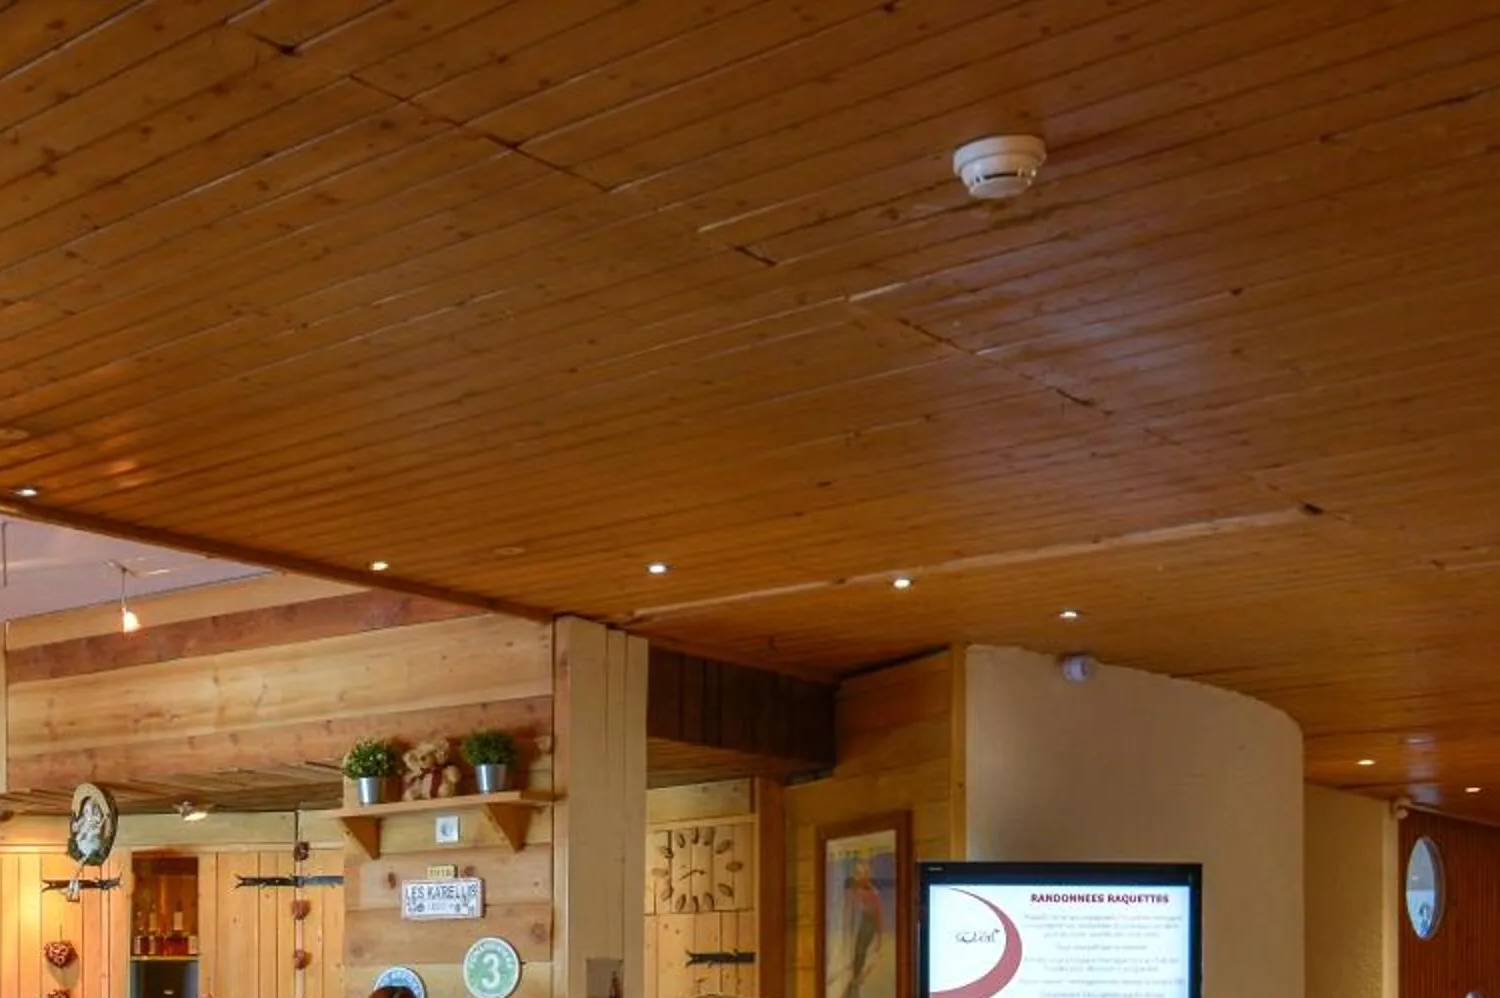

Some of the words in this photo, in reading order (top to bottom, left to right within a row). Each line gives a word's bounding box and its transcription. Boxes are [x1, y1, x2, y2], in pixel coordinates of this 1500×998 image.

[1031, 893, 1104, 904] RANDONNEES
[1108, 893, 1169, 905] RAQUETTES
[481, 953, 501, 989] 3
